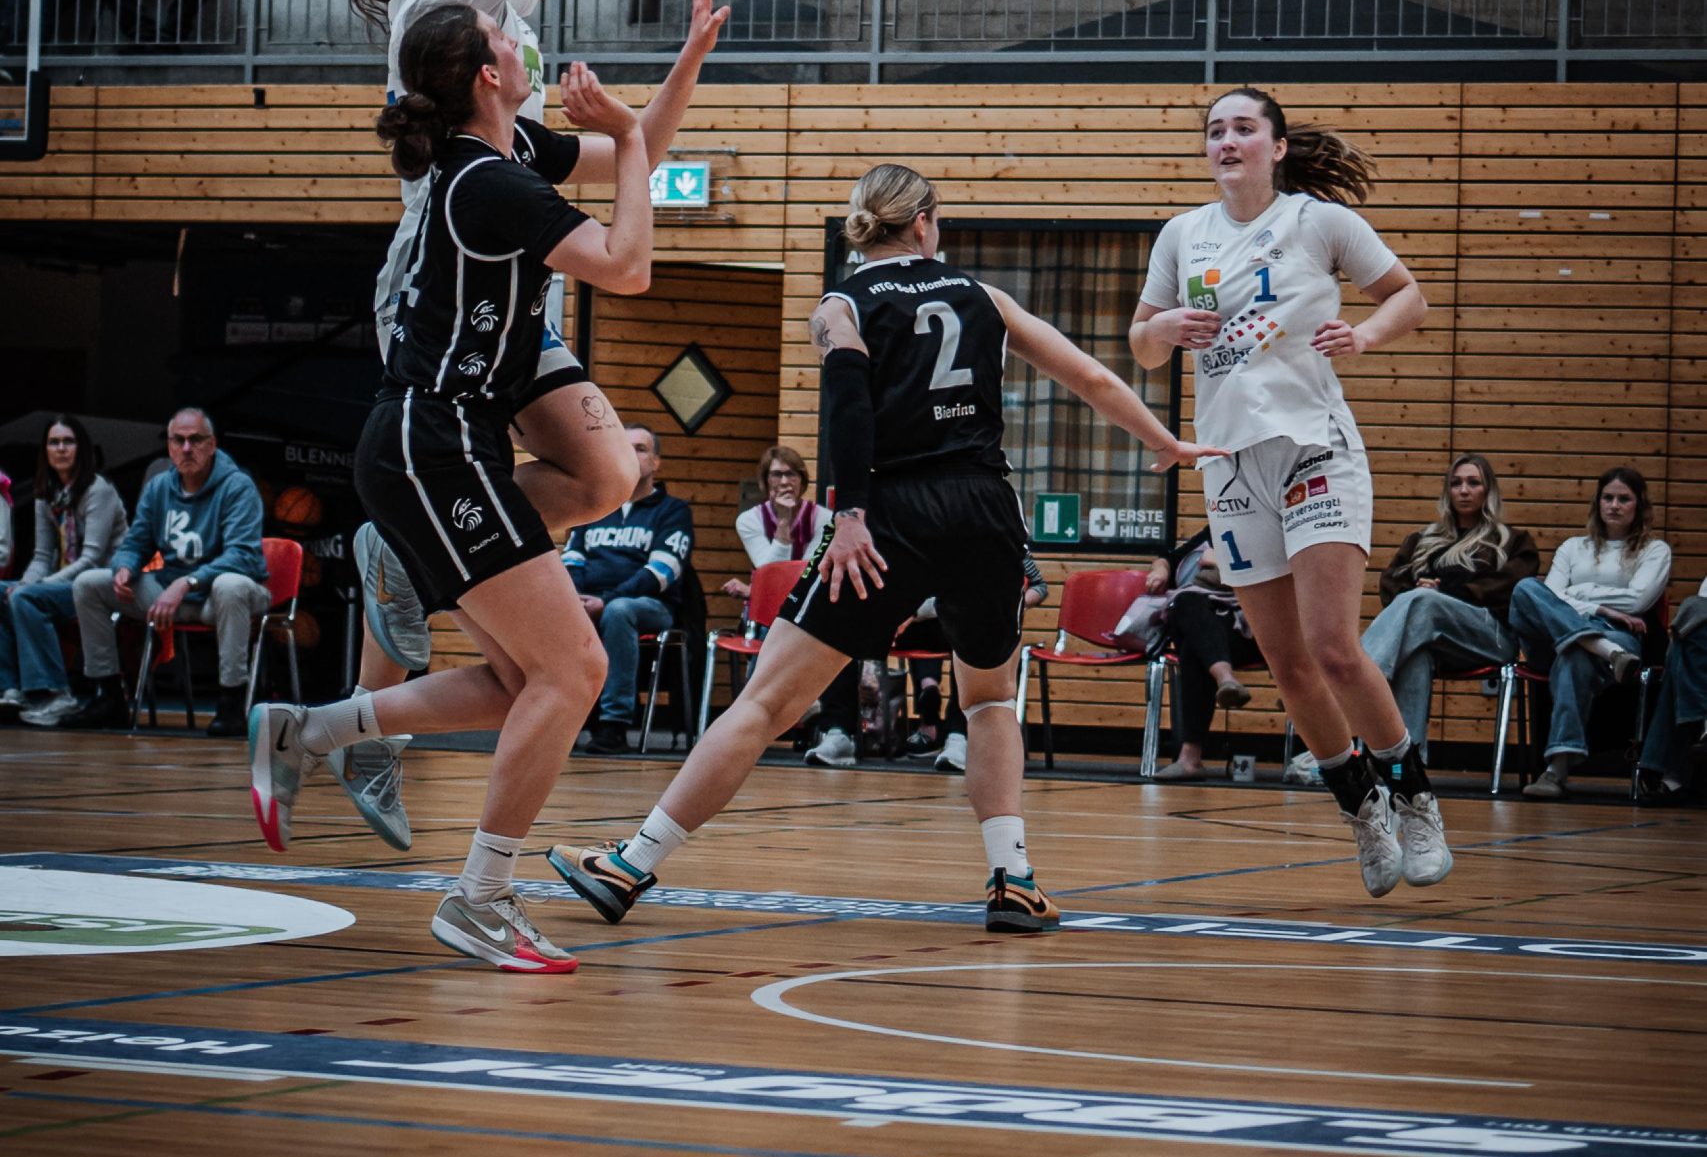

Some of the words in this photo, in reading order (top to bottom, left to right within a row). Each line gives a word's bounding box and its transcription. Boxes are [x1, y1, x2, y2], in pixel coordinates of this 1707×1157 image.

[868, 282, 896, 295] HTG
[916, 276, 971, 294] Homburg
[1254, 267, 1278, 302] 1
[913, 300, 973, 391] 2
[1117, 509, 1165, 523] ERSTE
[583, 525, 654, 552] BOCHUM
[1119, 526, 1161, 539] HILFE
[1221, 530, 1253, 571] 1
